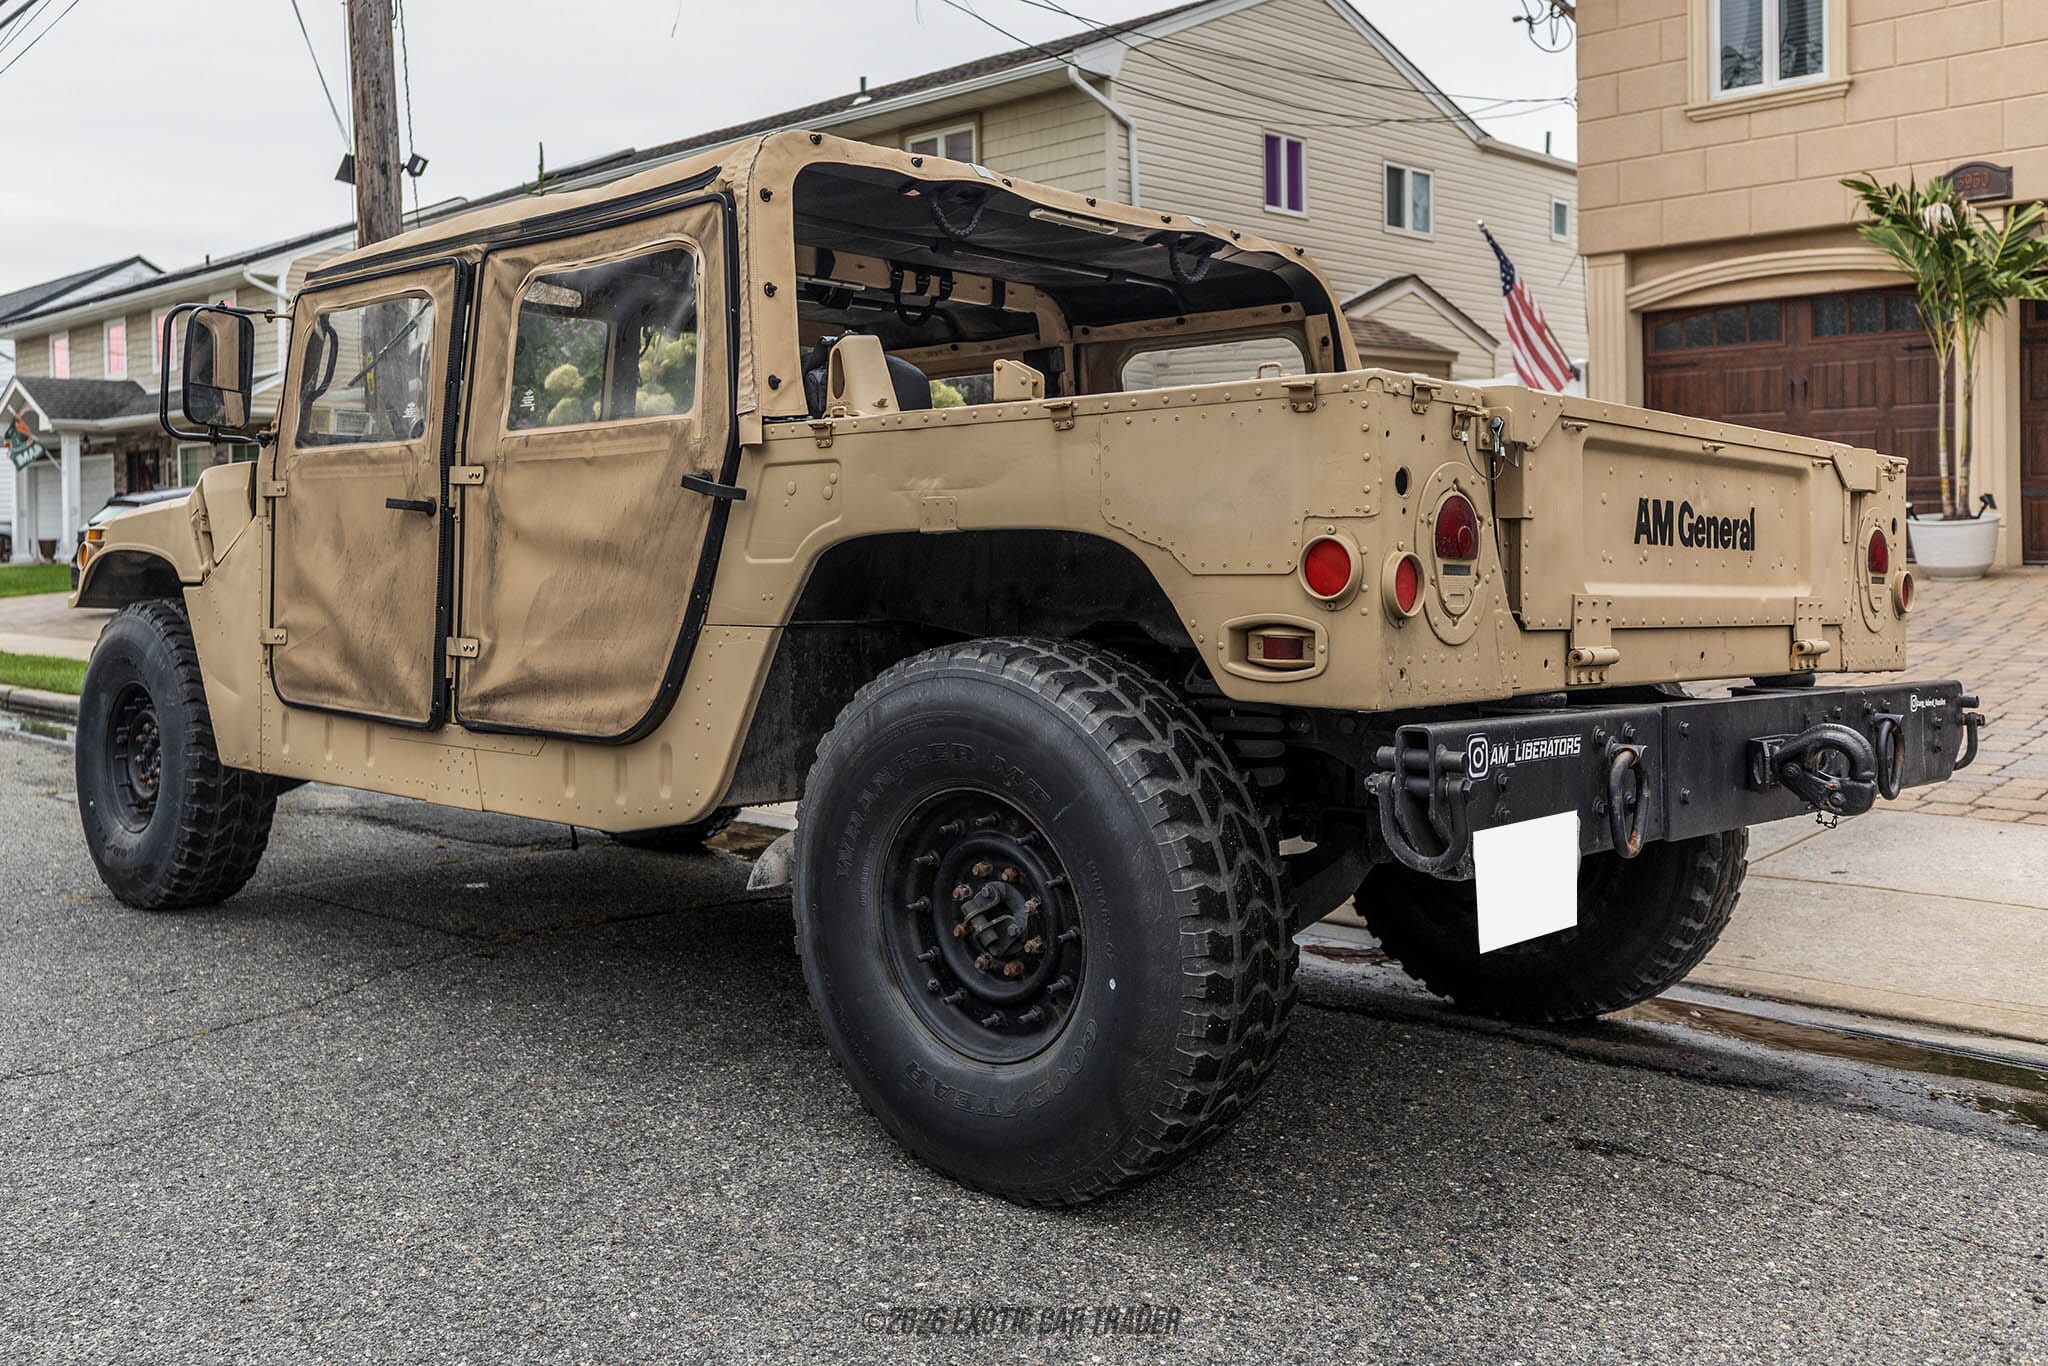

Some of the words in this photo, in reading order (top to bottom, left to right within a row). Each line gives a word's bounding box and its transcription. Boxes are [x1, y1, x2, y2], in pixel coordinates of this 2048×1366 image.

[1634, 497, 1674, 547] AM
[1678, 500, 1756, 551] General
[1489, 736, 1582, 768] AM_LIBERATORS
[833, 742, 977, 881] WRANGLER
[904, 1018, 1097, 1118] GOODYEAR
